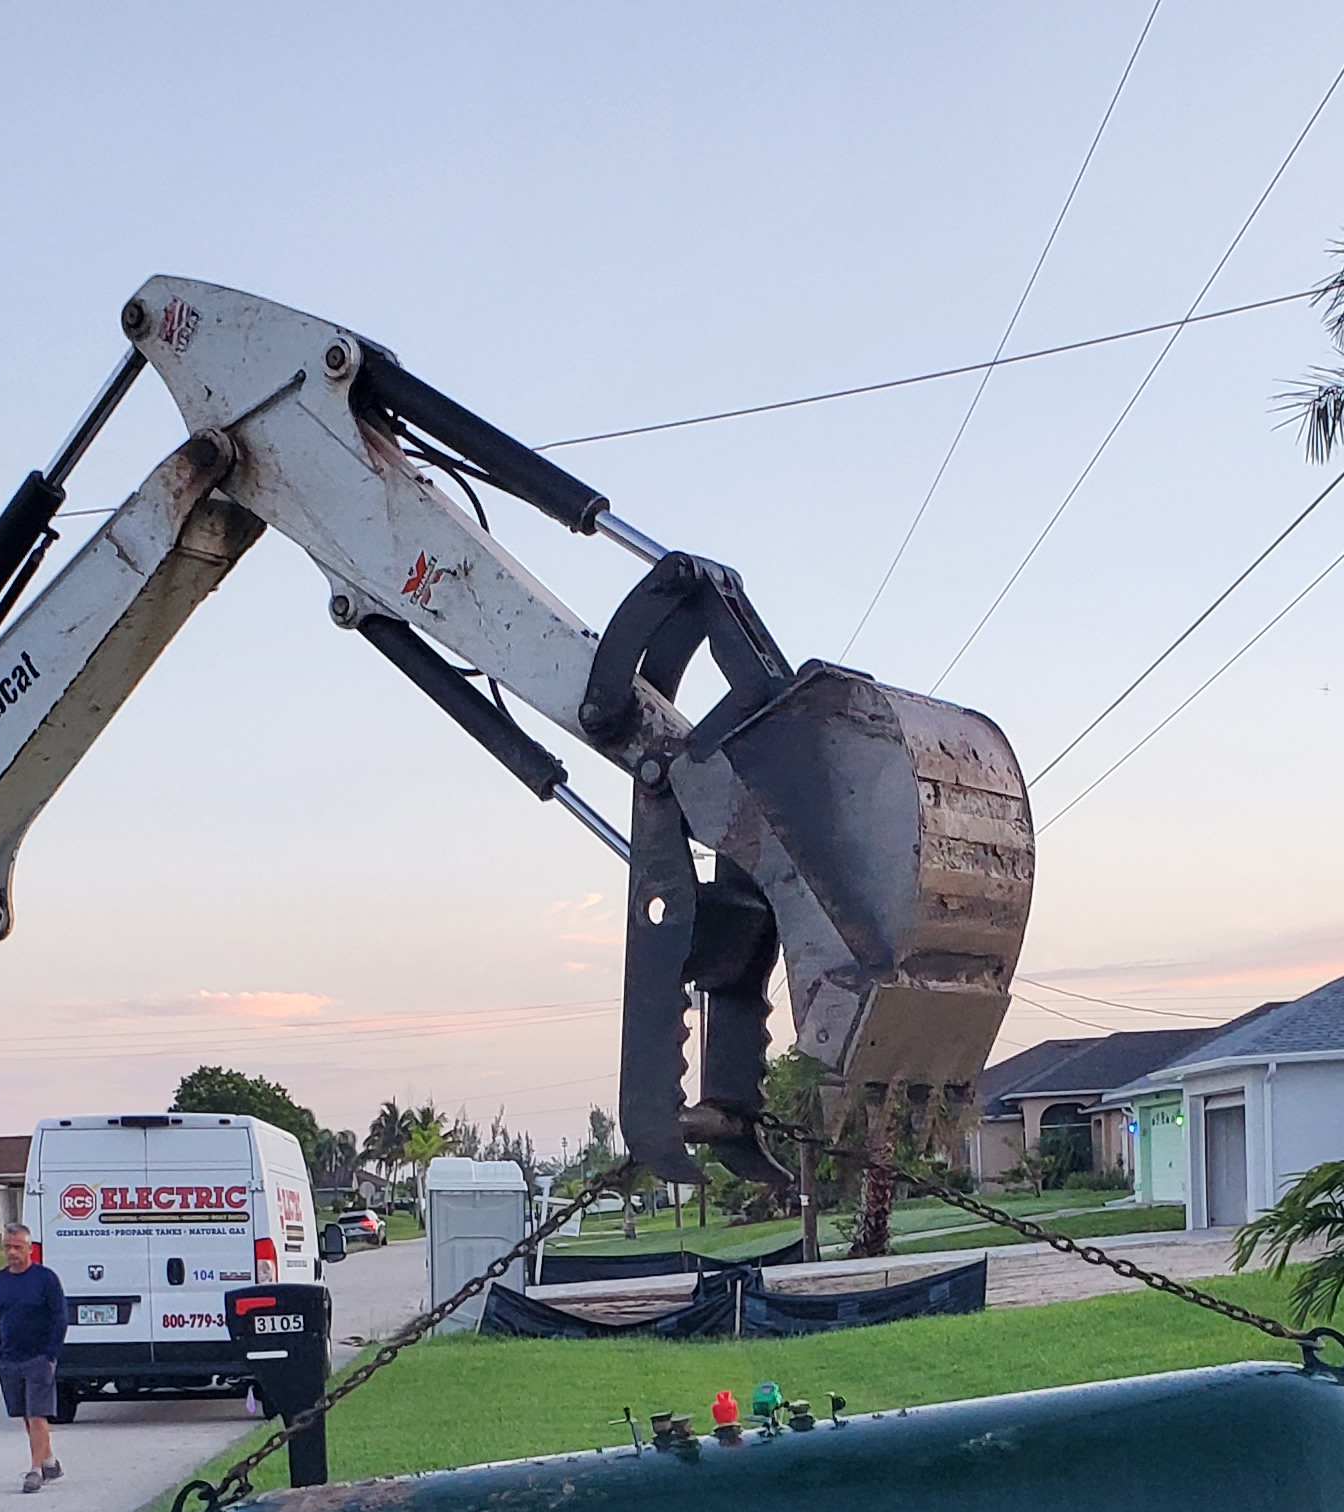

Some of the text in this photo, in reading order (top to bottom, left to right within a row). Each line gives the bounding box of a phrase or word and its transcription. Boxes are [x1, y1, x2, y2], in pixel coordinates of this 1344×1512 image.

[64, 1186, 247, 1210] RCS ELECTRIC
[56, 1229, 110, 1237] GENERATORS
[115, 1228, 153, 1236] PROPANE
[189, 1227, 226, 1235] NATURAL
[193, 1270, 214, 1280] 104
[162, 1313, 226, 1328] 800-779-3
[257, 1315, 302, 1332] 3105
